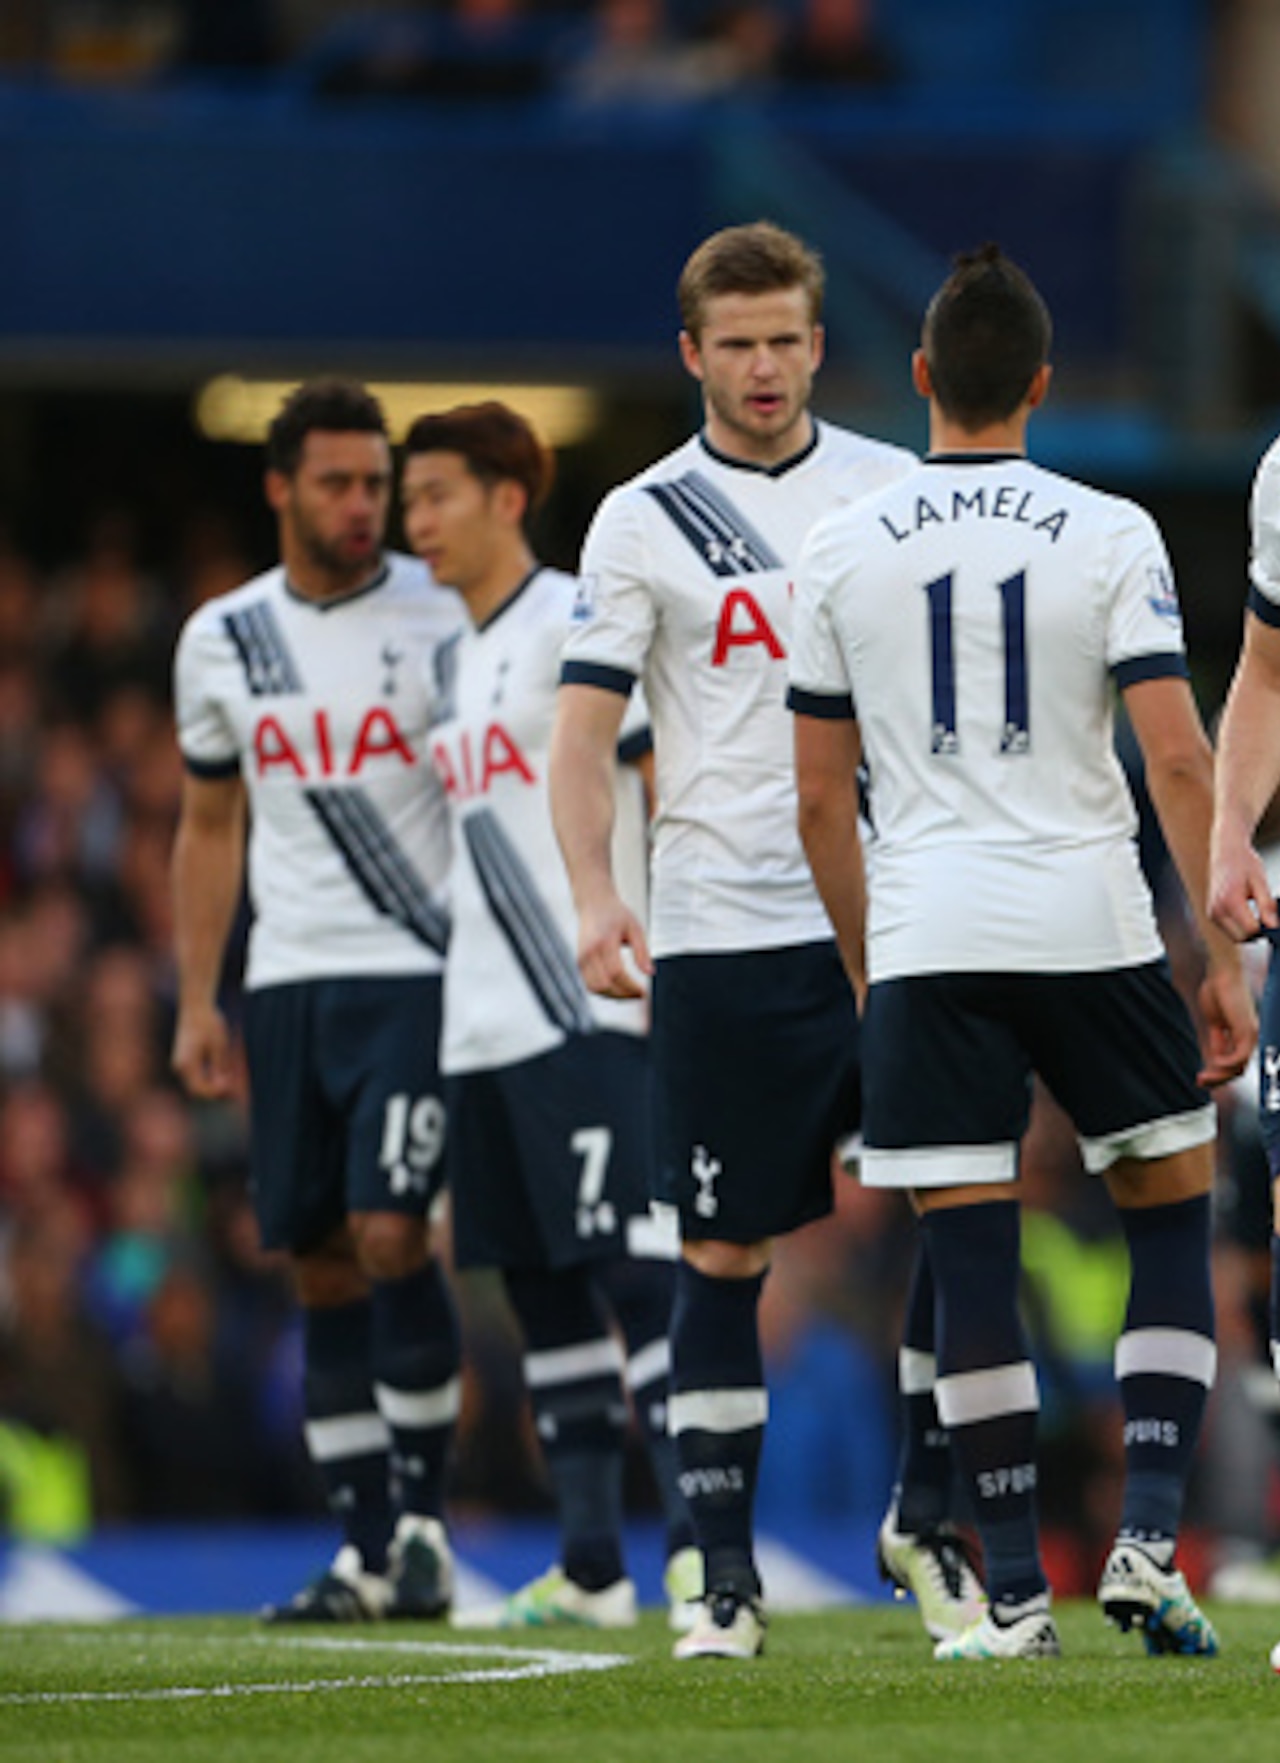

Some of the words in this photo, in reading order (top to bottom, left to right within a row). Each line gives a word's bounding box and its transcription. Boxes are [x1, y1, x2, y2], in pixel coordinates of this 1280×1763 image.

[879, 486, 1069, 543] LAMELA
[923, 566, 1031, 755] 11
[253, 706, 418, 780] AIA
[379, 1093, 447, 1171] 19
[570, 1125, 612, 1206] 7
